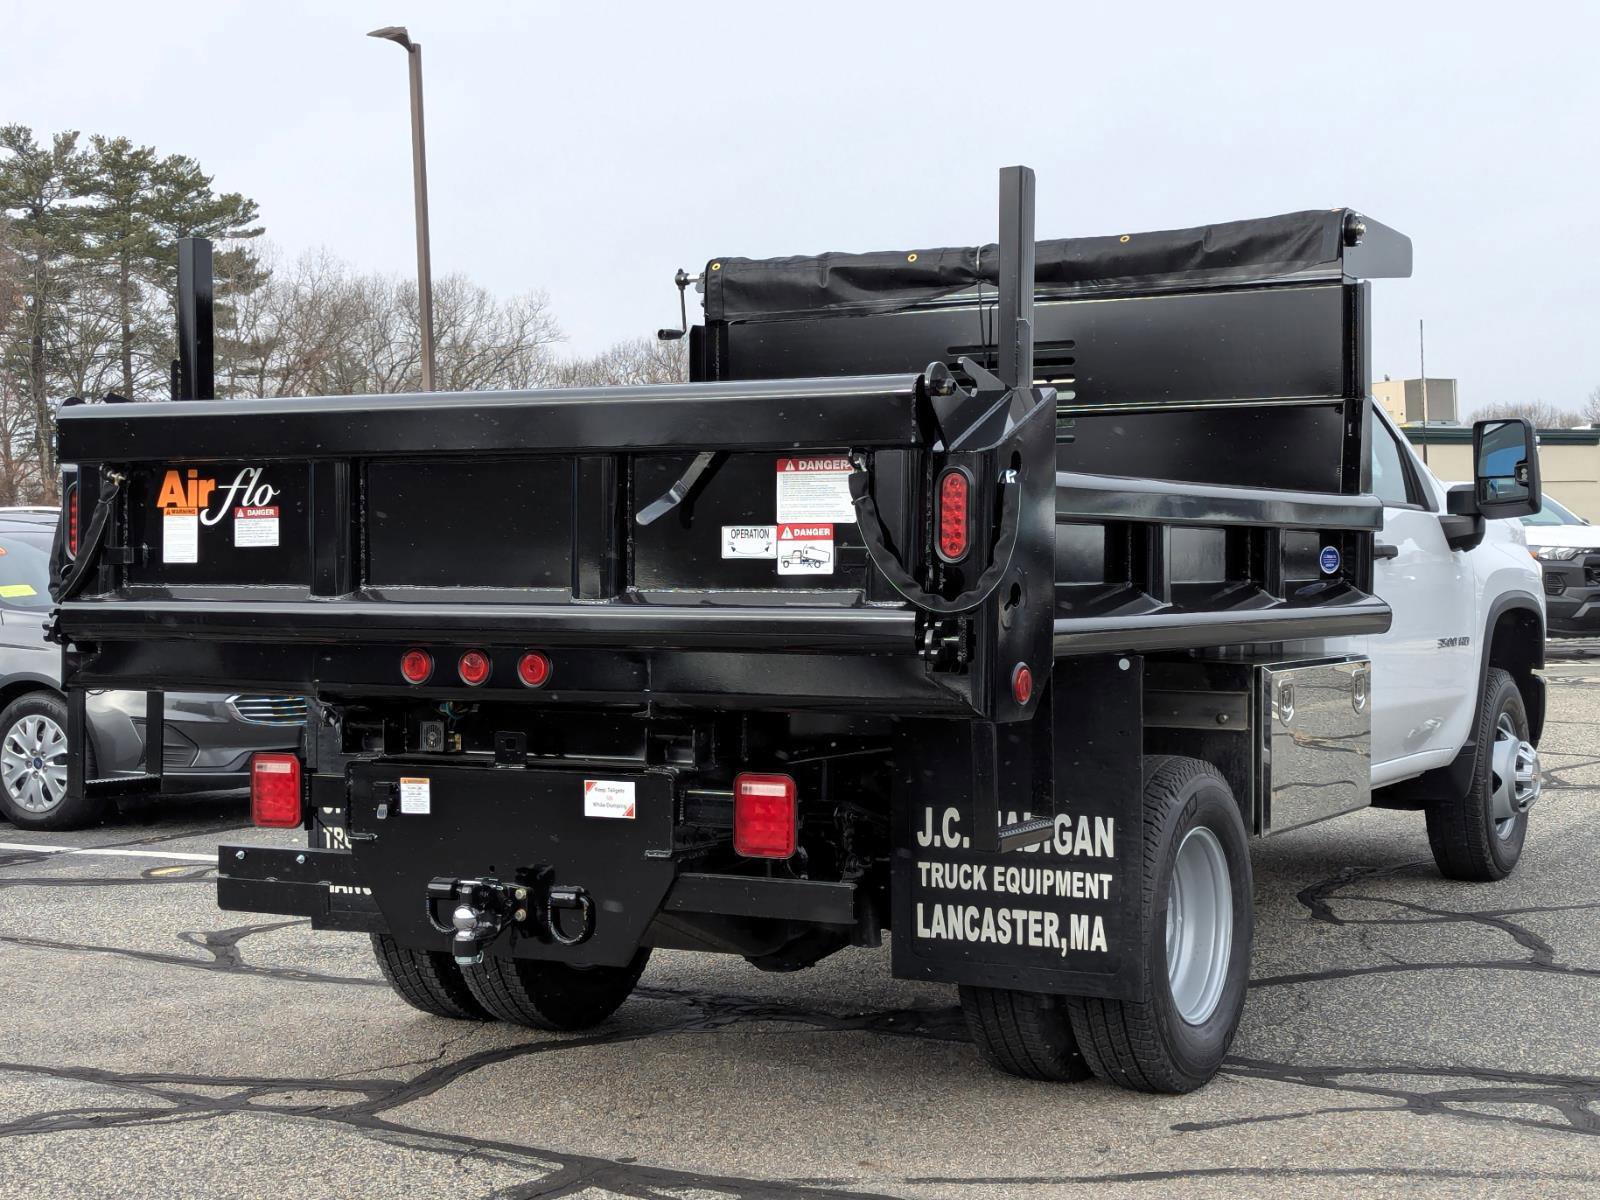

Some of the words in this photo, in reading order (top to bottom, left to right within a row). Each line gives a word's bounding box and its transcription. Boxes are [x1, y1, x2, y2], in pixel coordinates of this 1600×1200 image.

[798, 460, 849, 470] DANGER
[157, 469, 215, 507] Air
[200, 467, 280, 526] flo
[247, 508, 274, 516] DANGER
[731, 528, 770, 539] OPERATION
[793, 528, 831, 537] DANGER
[916, 806, 970, 849] J.C.
[917, 861, 988, 891] TRUCK
[993, 865, 1113, 900] EQUIPMENT
